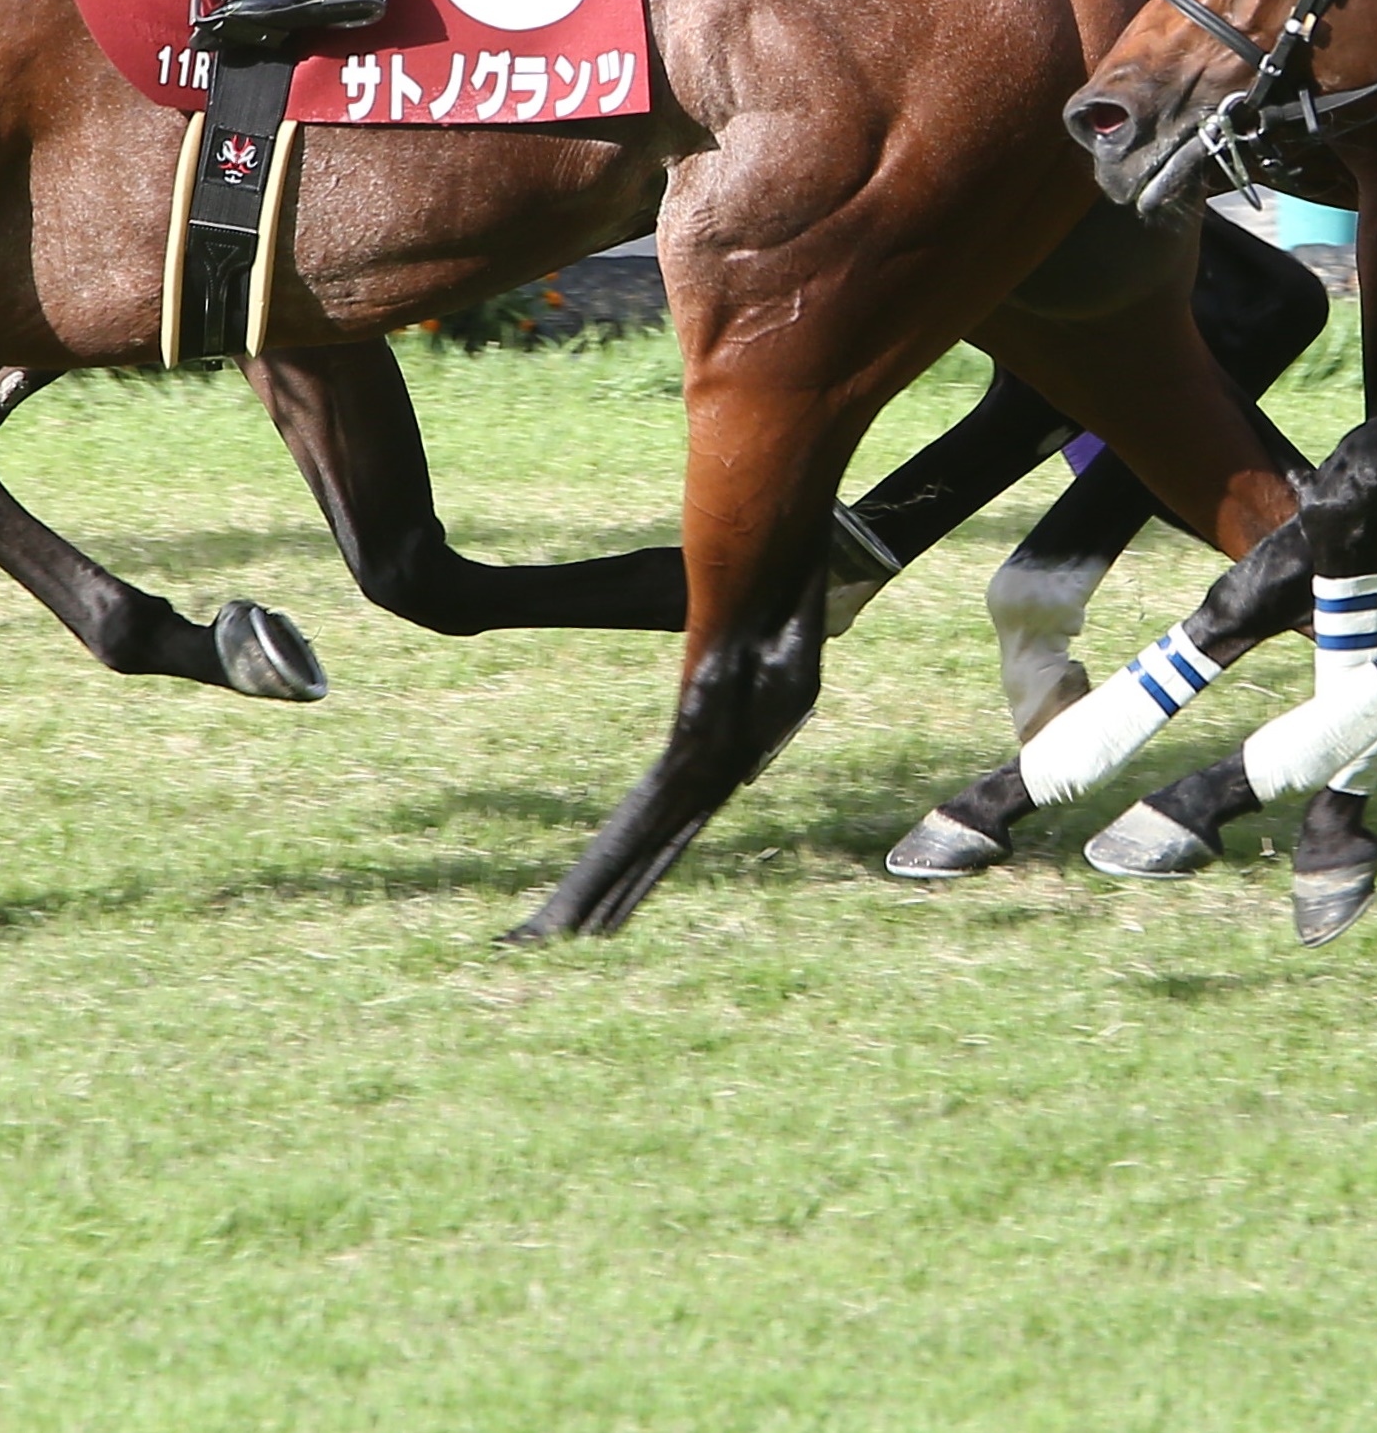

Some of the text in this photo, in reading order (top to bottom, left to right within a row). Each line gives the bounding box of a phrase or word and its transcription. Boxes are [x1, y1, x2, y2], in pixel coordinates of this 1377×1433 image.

[158, 45, 210, 89] 11R
[340, 49, 635, 121] サトノグランツ
